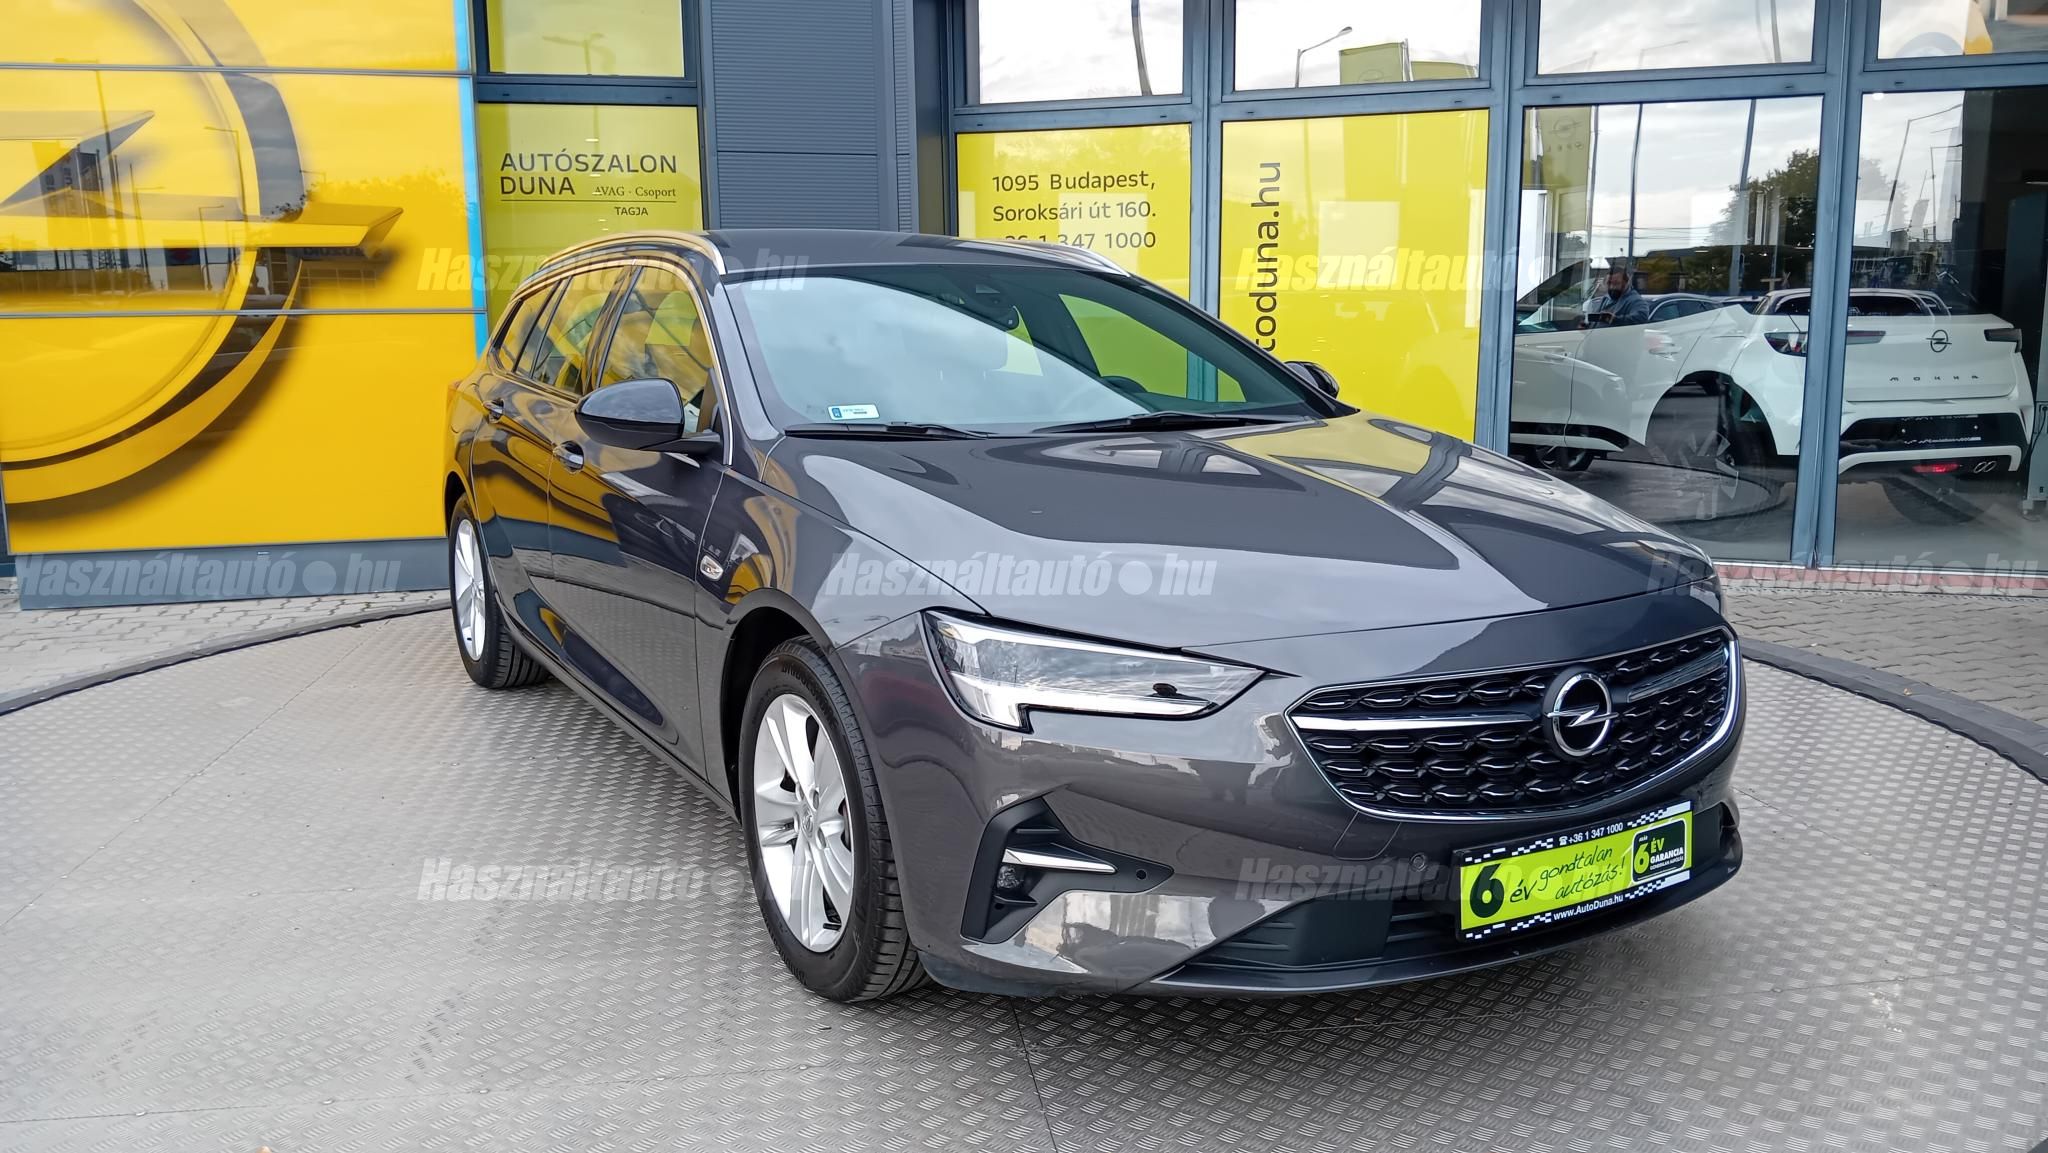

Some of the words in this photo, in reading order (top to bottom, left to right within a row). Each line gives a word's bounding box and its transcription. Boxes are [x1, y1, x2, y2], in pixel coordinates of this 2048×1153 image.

[499, 148, 678, 174] AUTÓSZALON
[500, 176, 576, 195] DUNA
[992, 175, 1039, 192] 1095
[1050, 170, 1156, 192] Budapest,
[635, 186, 677, 199] Csoport
[614, 206, 649, 216] TAGJA
[993, 203, 1083, 222] Soroksári
[1088, 202, 1111, 219] út
[1116, 200, 1157, 219] 160.
[1105, 231, 1156, 249] 1000
[1591, 827, 1605, 839] 347
[1606, 822, 1624, 834] 1000
[1634, 842, 1650, 874] 6
[1650, 837, 1665, 853] ÉV
[1650, 847, 1684, 864] GARANCIA
[1537, 845, 1613, 891] gondtalan
[1469, 862, 1505, 919] 6
[1509, 879, 1538, 903] év
[1553, 894, 1624, 921] www.AutoDuna.hu
